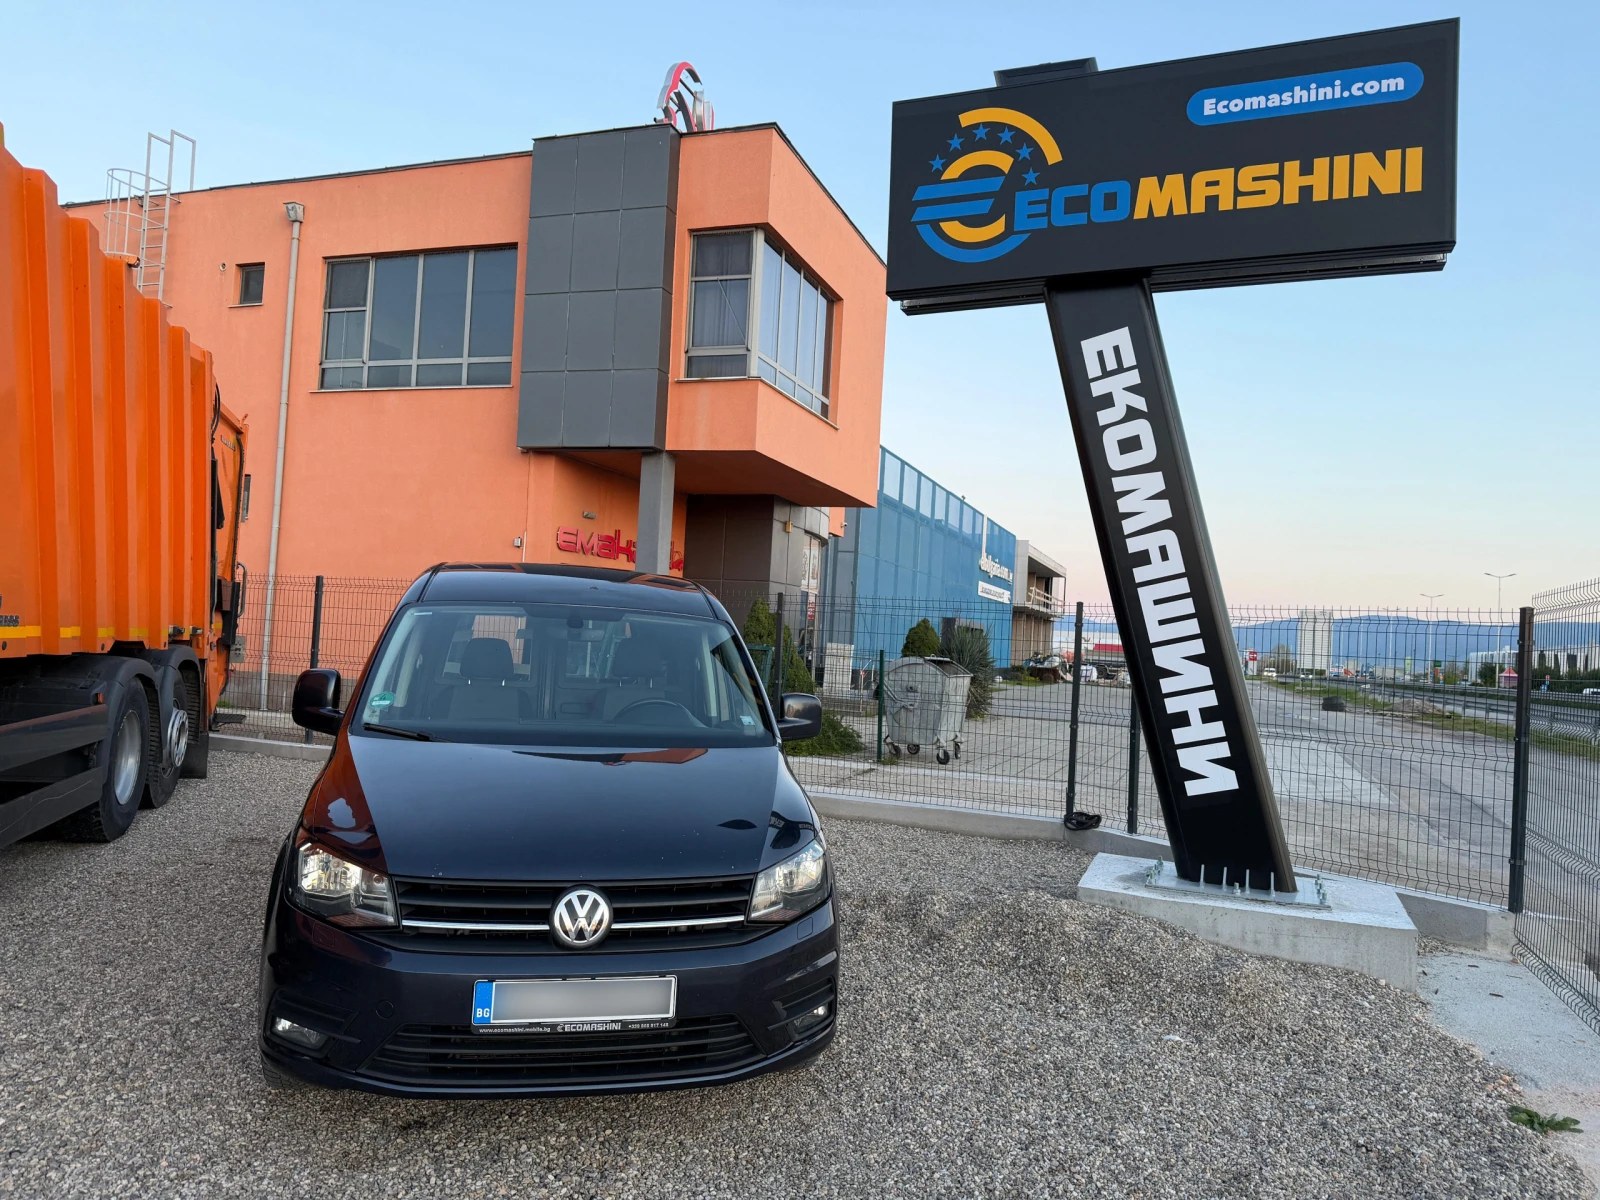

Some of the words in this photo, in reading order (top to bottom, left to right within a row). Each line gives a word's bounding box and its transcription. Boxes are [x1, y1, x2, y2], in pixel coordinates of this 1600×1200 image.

[1203, 75, 1405, 116] Ecomashini.com
[1014, 146, 1423, 232] ECOMASHINI
[1080, 326, 1239, 797] ЕКОМАШИНИ
[476, 1007, 490, 1018] BG
[565, 1022, 621, 1032] ECOMASHINI
